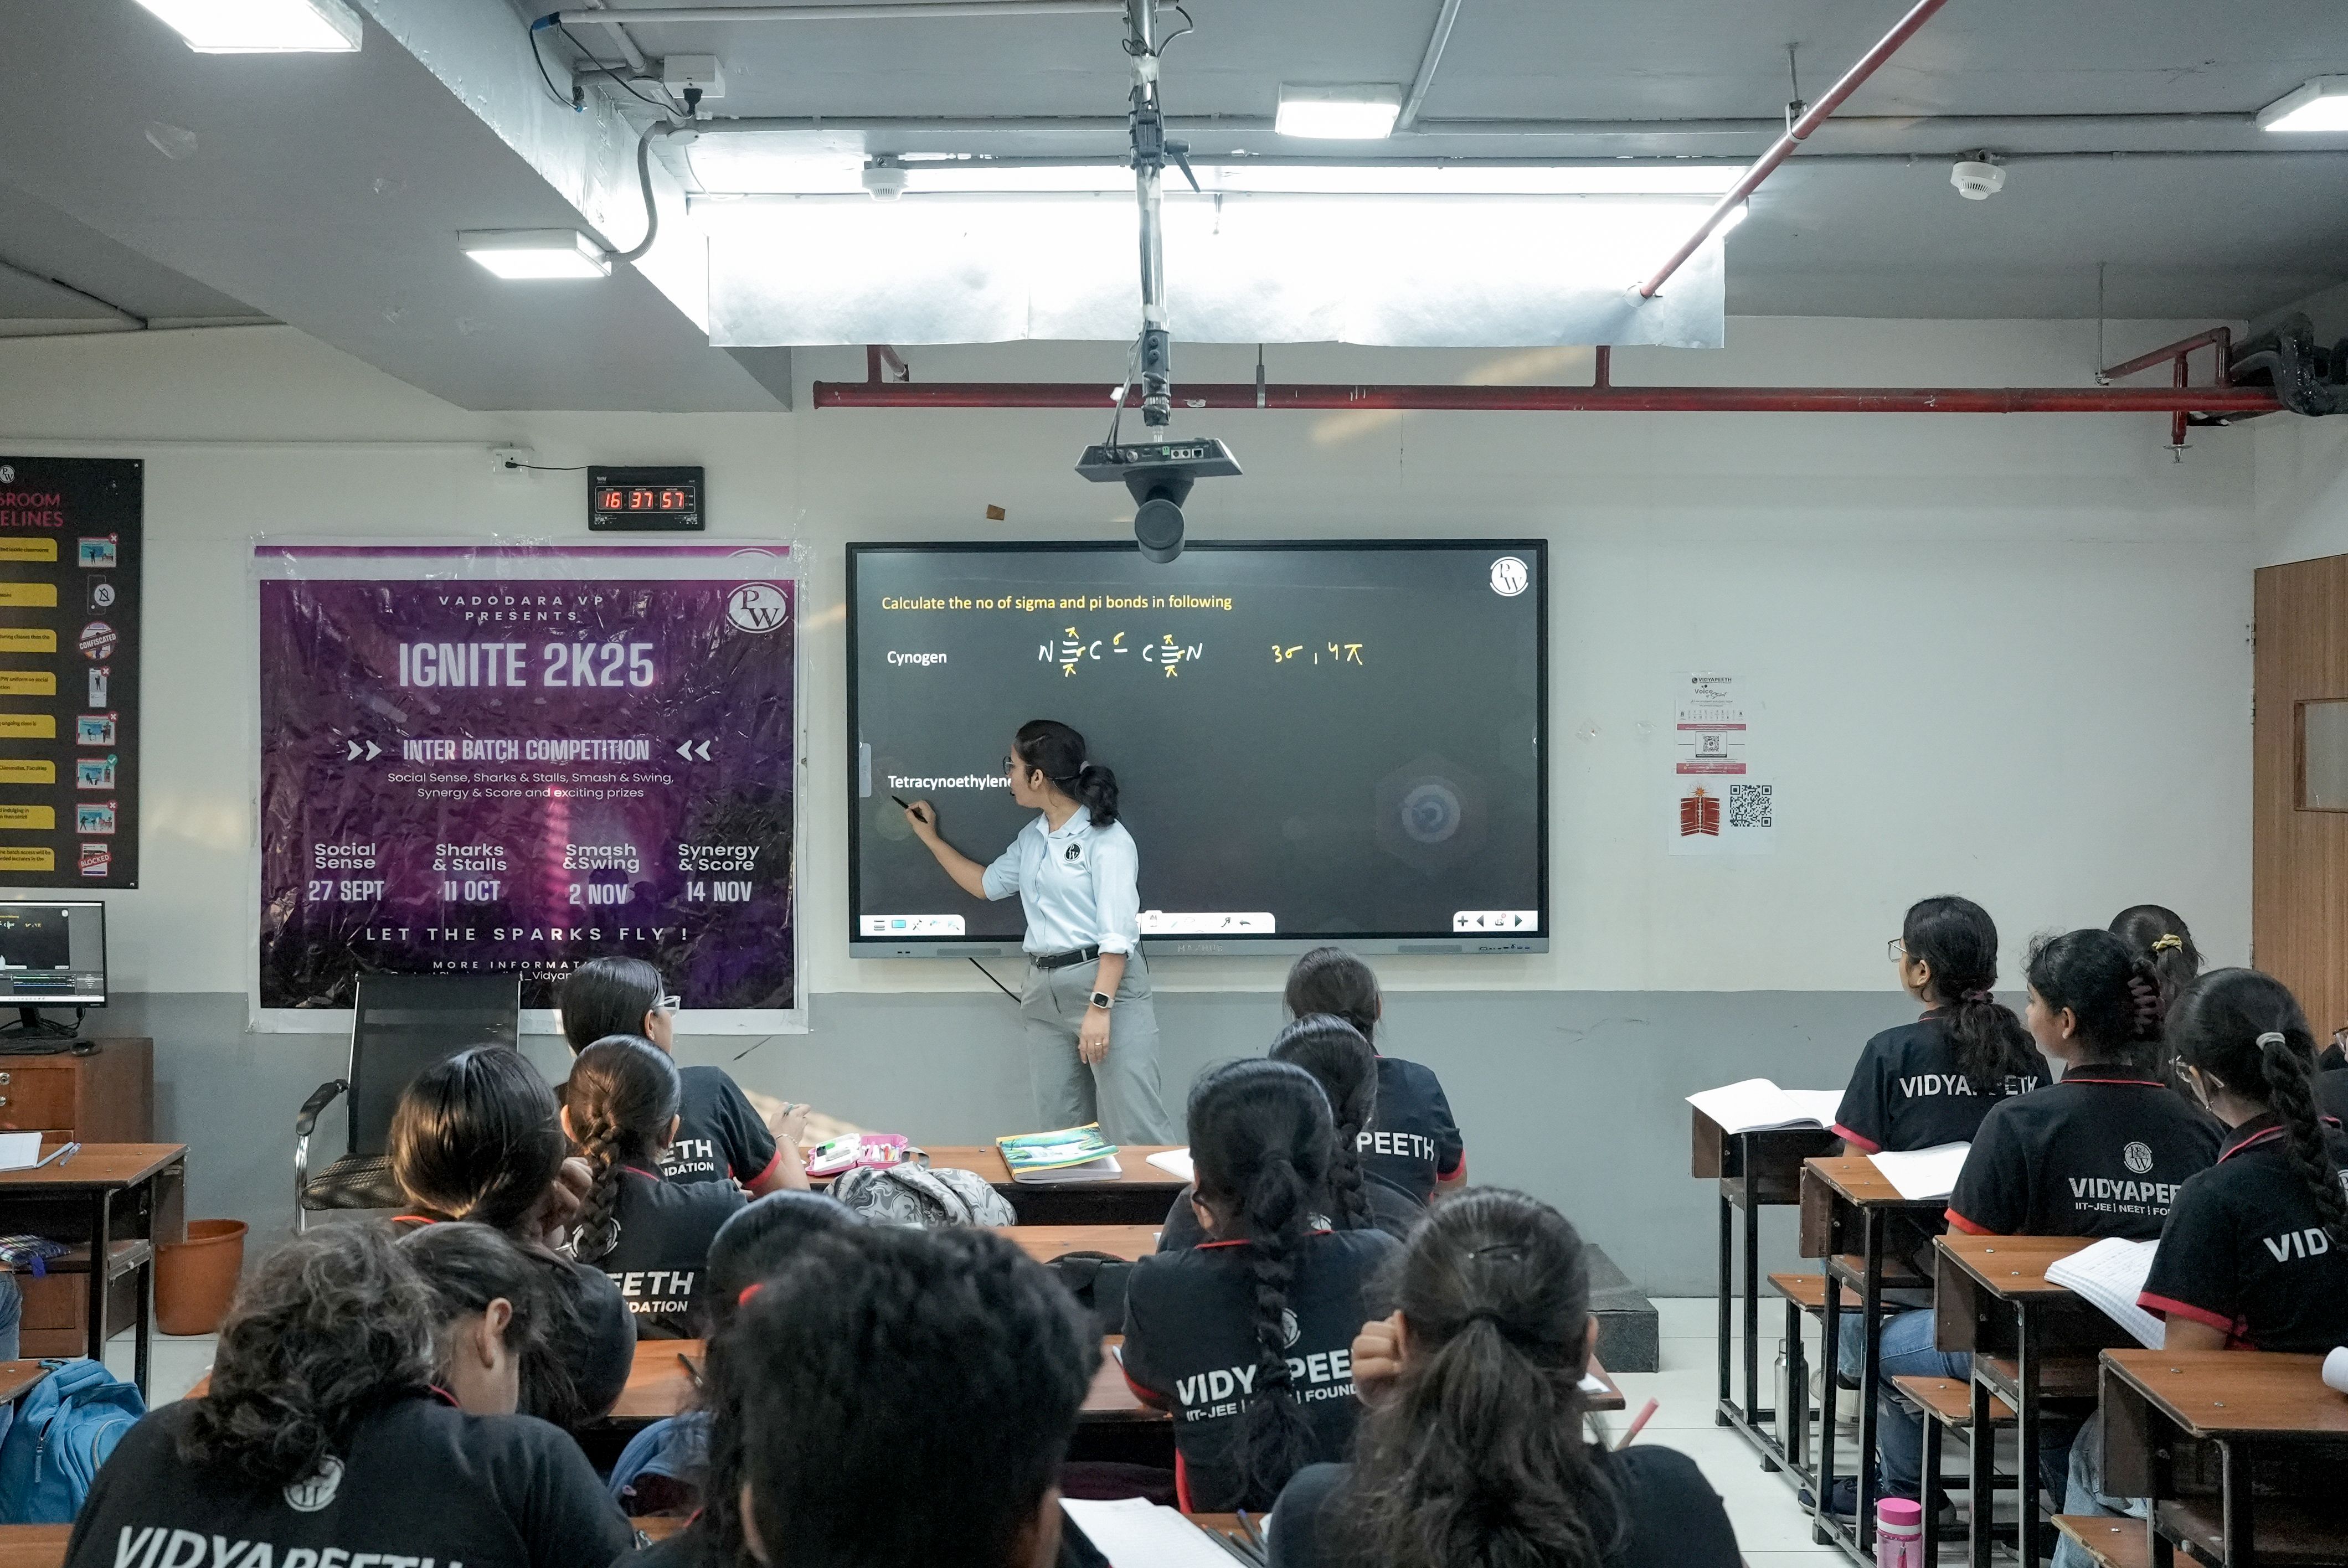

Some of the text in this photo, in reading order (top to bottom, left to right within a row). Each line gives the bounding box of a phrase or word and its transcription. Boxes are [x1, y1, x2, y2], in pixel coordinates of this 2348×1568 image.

[606, 492, 683, 508] 16 37 57
[439, 596, 603, 605] VADODARA VP
[882, 595, 1232, 612] Calculate the no of sigma and pi bonds in following
[740, 590, 780, 628] PW
[465, 612, 576, 621] PRESENTS
[79, 633, 116, 650] CONFISCATED
[399, 643, 654, 687] IGNITE 2K25
[887, 651, 947, 666] Cynogen
[404, 740, 649, 760] INTER BATCH COMPETITION
[388, 772, 674, 785] Social Sense, Sharks & Stalls, Smash & Swing,
[418, 788, 644, 800] Synergy & Score and exciting prizes
[315, 843, 375, 856] Social
[436, 843, 504, 856] Sharks
[566, 843, 636, 856] Smash
[678, 843, 760, 860] Synergy
[80, 854, 110, 867] BLOCKED
[315, 856, 376, 869] Sense
[432, 858, 507, 871] & Stalls
[678, 858, 754, 871] & Score
[308, 880, 385, 901] 27 SEPT
[444, 880, 501, 901] 11 OCT
[569, 884, 628, 905] 2 NOV
[687, 881, 752, 901] 14 NOV
[366, 928, 409, 941] LET
[427, 928, 475, 941] THE
[493, 928, 601, 941] SPARKS
[620, 928, 664, 941] FLY
[1899, 1074, 2038, 1098] VIDYAETH
[2119, 1204, 2145, 1214] NEET
[2153, 1207, 2170, 1216] FO
[2263, 1226, 2335, 1263] VID
[626, 1301, 688, 1313] DATION
